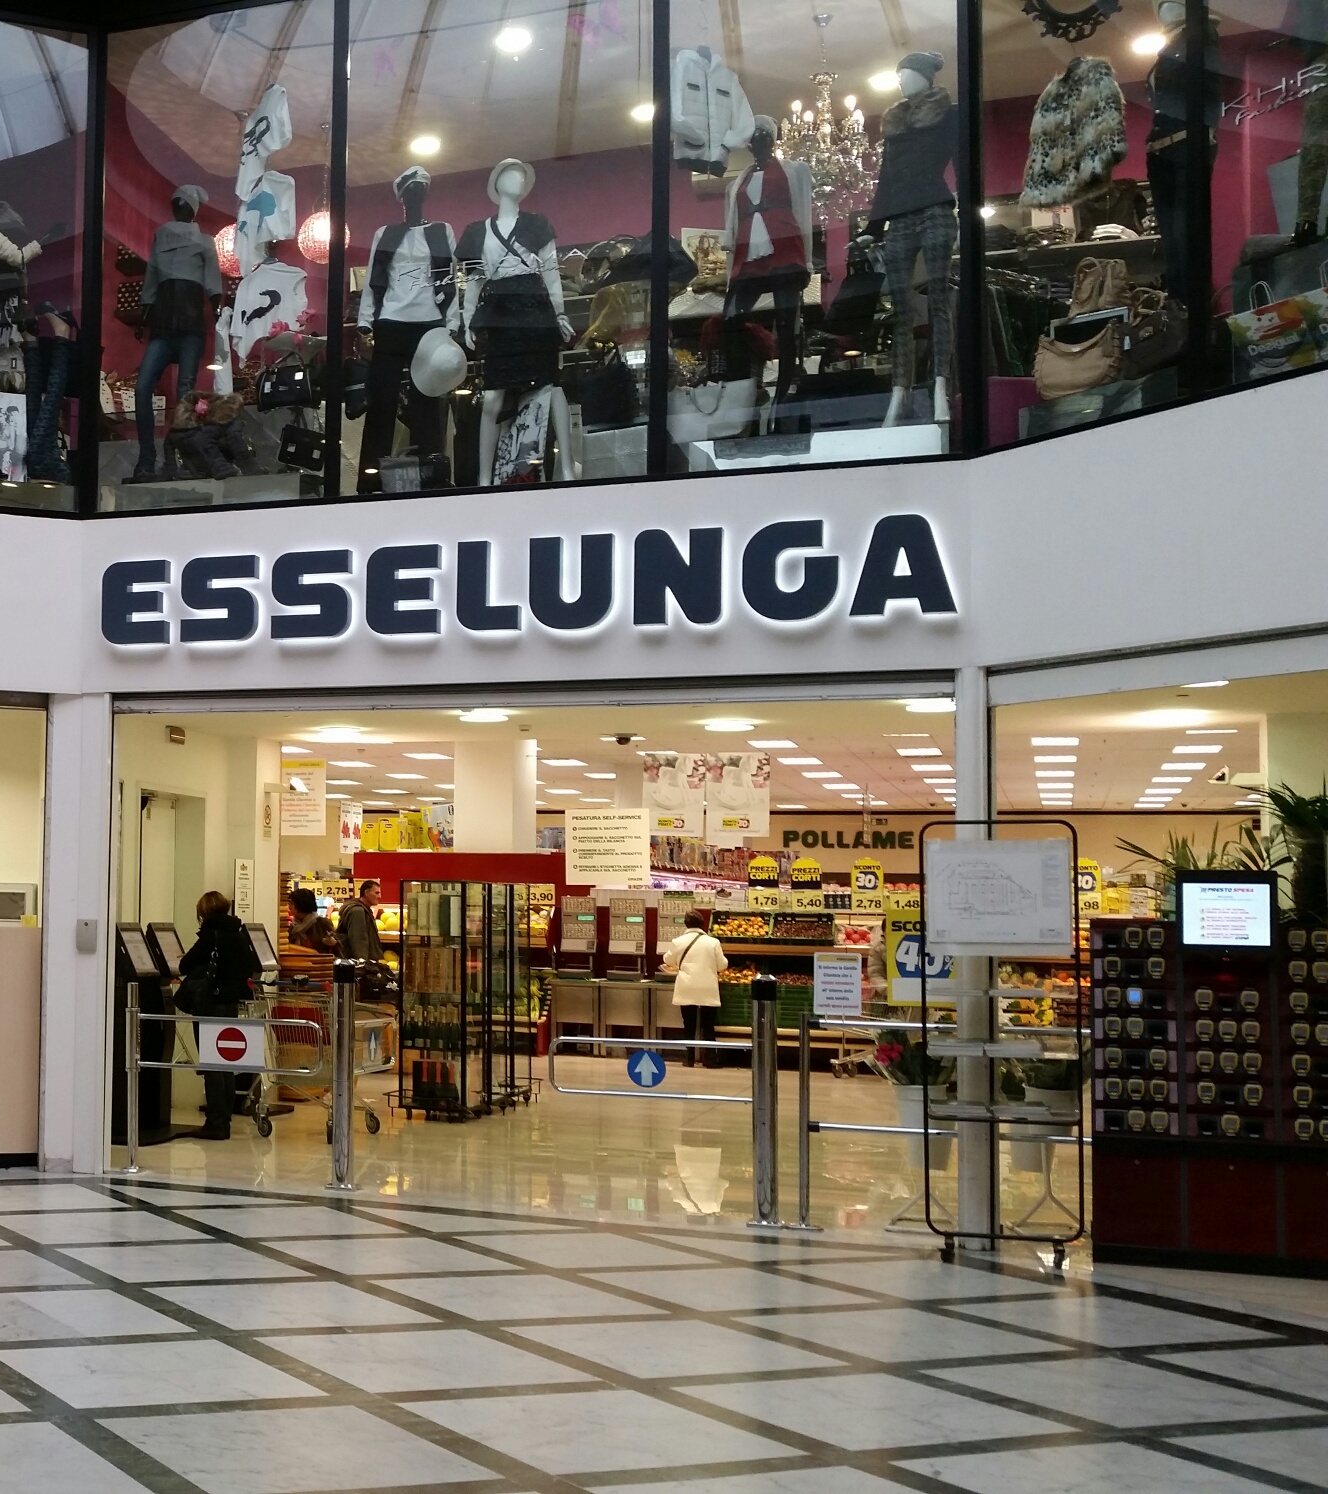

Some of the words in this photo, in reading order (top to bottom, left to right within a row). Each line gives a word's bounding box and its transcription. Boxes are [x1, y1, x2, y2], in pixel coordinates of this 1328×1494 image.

[1248, 332, 1299, 356] Desigual
[101, 513, 959, 645] ESSELUNGA
[783, 830, 915, 849] POLLAME
[792, 874, 821, 882] CORTI
[326, 887, 347, 896] 2,78
[530, 893, 553, 902] 3,90
[753, 897, 778, 906] 1,78
[796, 898, 822, 908] 5,40
[856, 899, 882, 909] 2,78
[894, 900, 920, 909] 1,48
[1080, 901, 1100, 912] ,98
[891, 921, 926, 932] SCO
